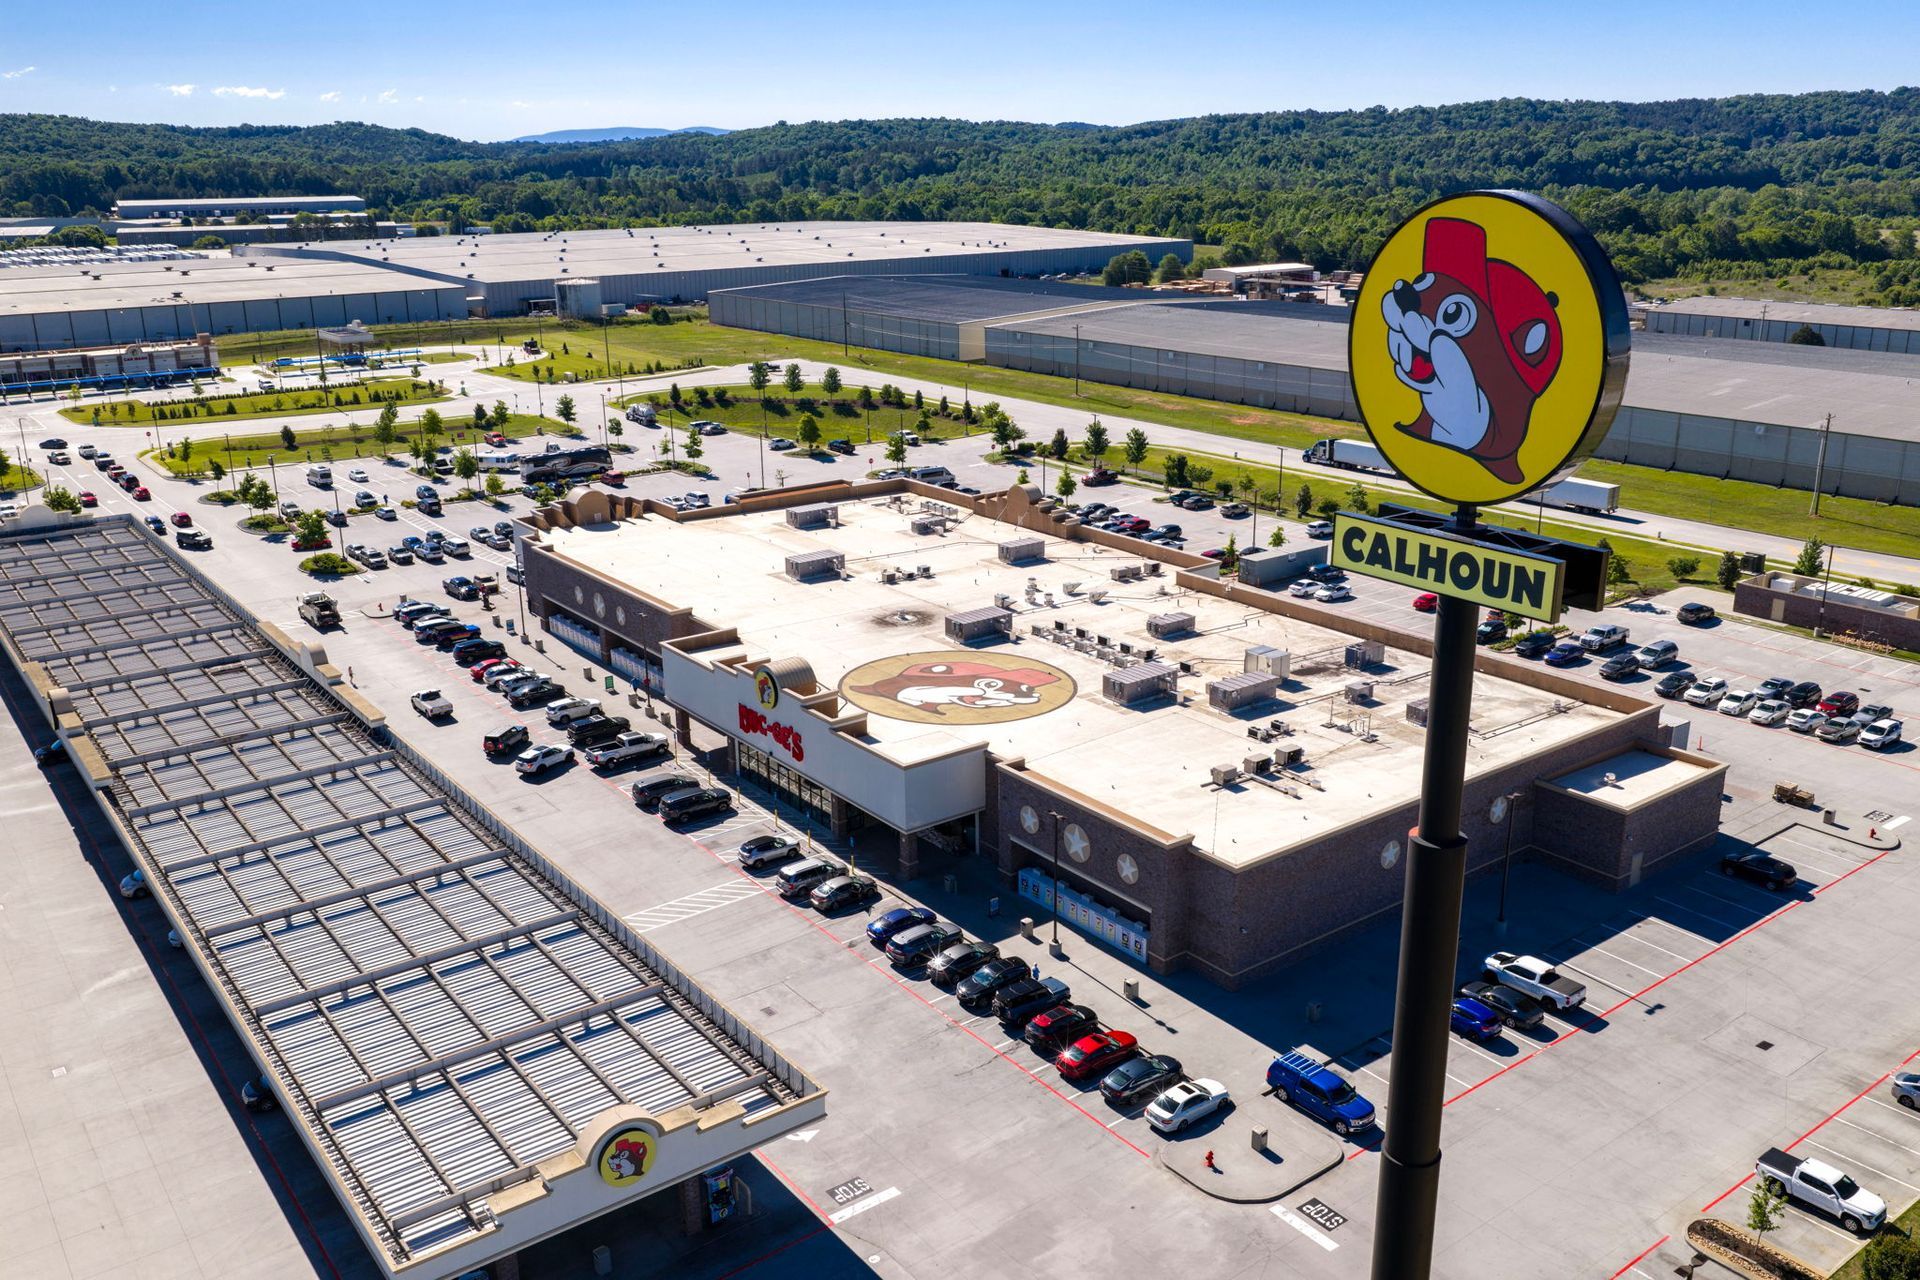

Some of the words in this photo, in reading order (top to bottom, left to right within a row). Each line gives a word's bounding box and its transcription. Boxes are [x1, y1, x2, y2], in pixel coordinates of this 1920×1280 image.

[1342, 526, 1546, 609] CALHOUN
[834, 1179, 870, 1203] STOP
[1302, 1204, 1344, 1228] STOP
